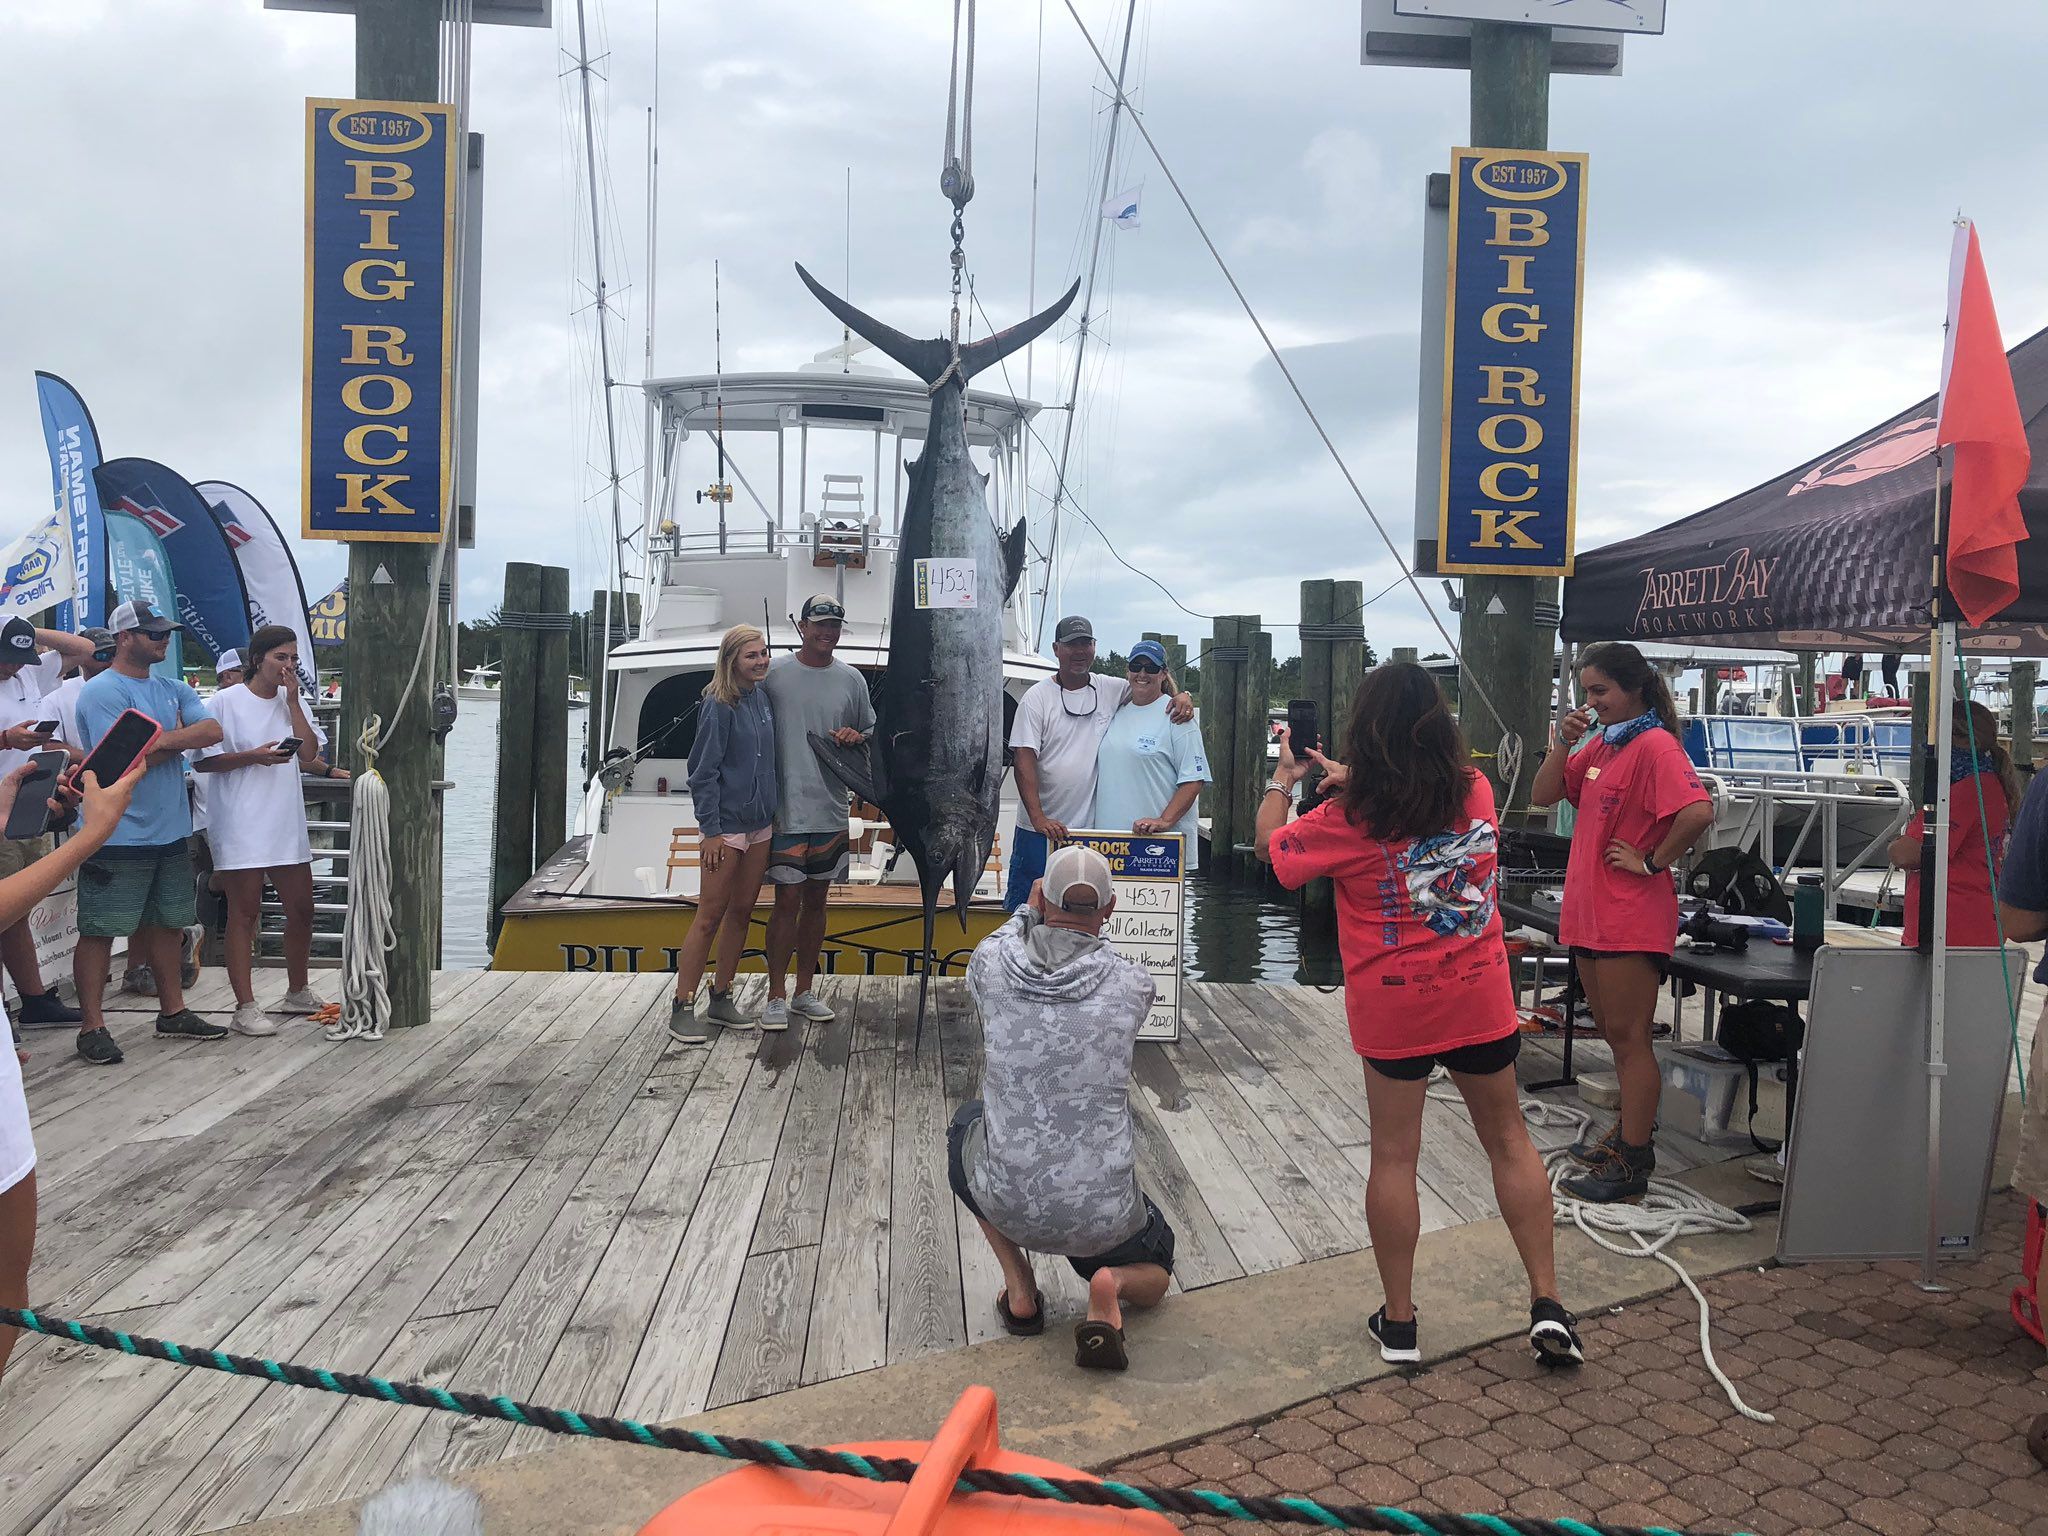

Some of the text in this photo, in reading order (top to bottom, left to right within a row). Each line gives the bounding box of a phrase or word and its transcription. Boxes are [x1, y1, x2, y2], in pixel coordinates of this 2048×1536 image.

[350, 116, 411, 136] EST 1957
[1491, 166, 1548, 185] EST 1957
[342, 159, 416, 301] BIG
[1480, 206, 1551, 344] BIG
[335, 324, 416, 515] ROCK
[1469, 364, 1547, 550] ROCK
[930, 567, 975, 595] 453.7
[1640, 606, 1774, 634] BOATWORKS
[1126, 887, 1170, 908] 453.7
[1124, 917, 1175, 937] Collector
[1149, 1013, 1174, 1029] 2020
